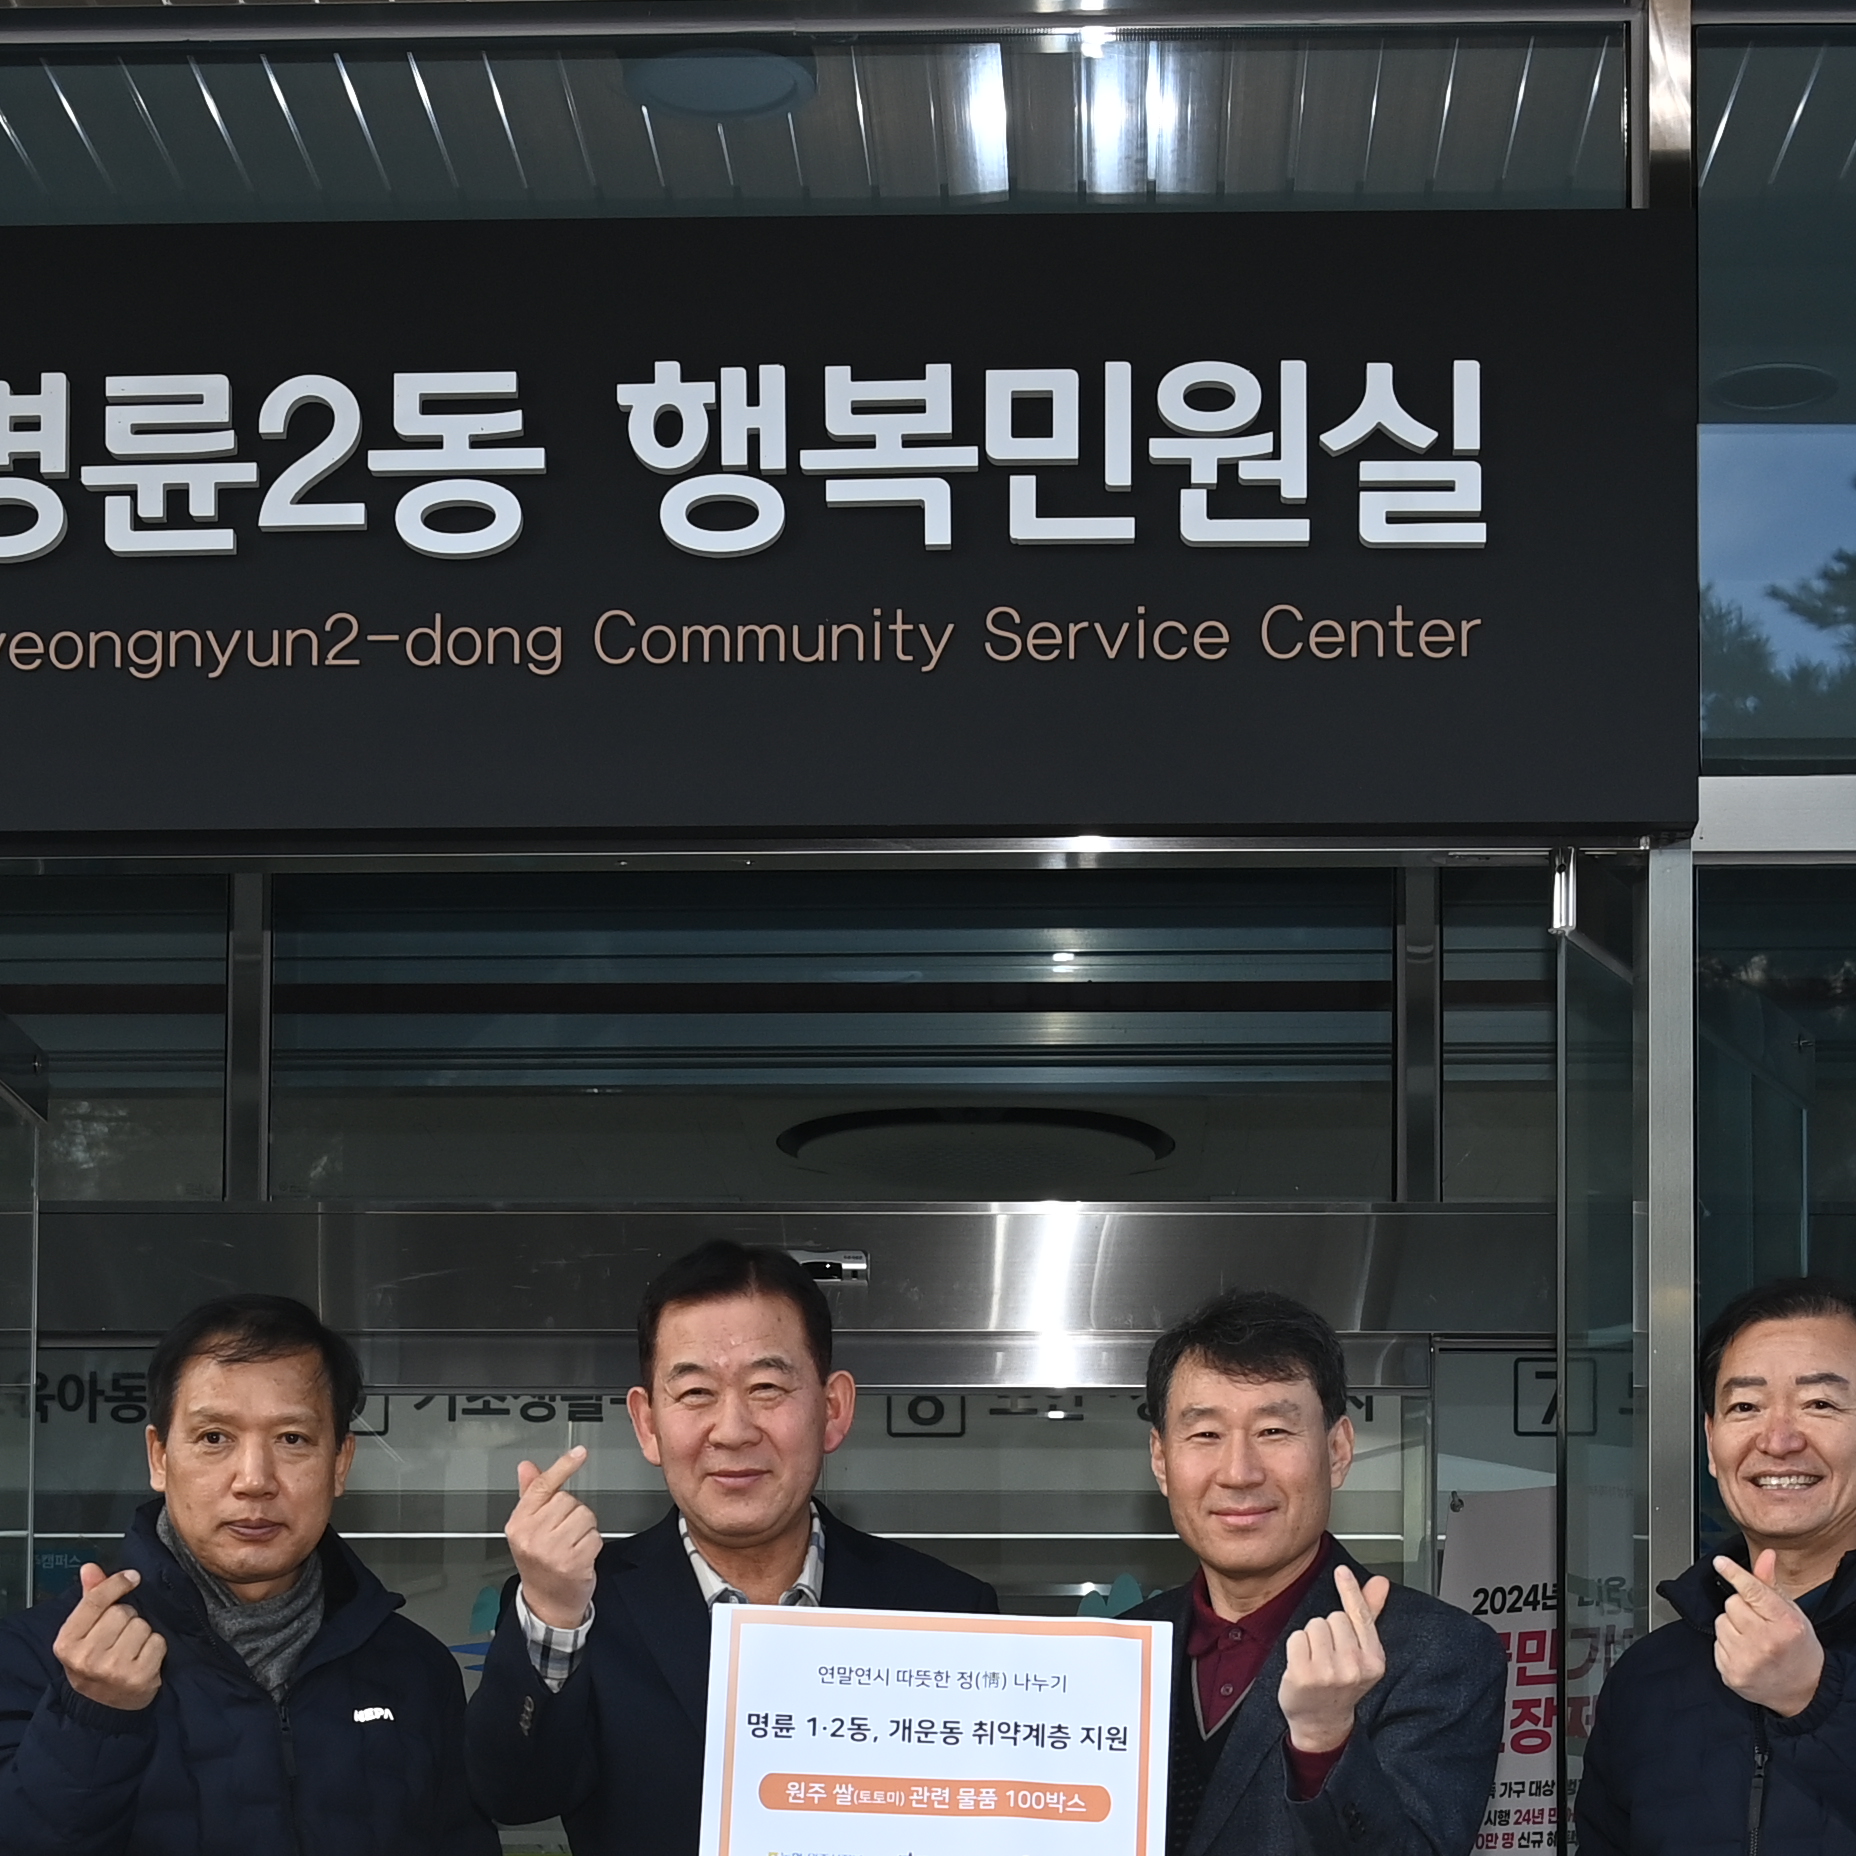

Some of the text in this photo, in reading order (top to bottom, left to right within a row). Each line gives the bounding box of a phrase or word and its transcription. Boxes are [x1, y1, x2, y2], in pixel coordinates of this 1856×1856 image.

[616, 359, 1487, 558] 행복민원실
[592, 607, 955, 672] Community
[983, 604, 1230, 662] Service
[1260, 603, 1483, 660] Center
[818, 1665, 1067, 1693] 연말연시 따뜻한 정(情) 나누기
[746, 1712, 796, 1739] 명륜
[888, 1719, 964, 1746] 개운동
[972, 1721, 1072, 1750] 취약계층
[1080, 1725, 1129, 1752] 지원
[785, 1781, 827, 1804] 원주
[909, 1786, 950, 1809] 관련
[956, 1788, 998, 1810] 물품
[1005, 1790, 1087, 1814] 100박스
[1513, 1807, 1544, 1826] 24년
